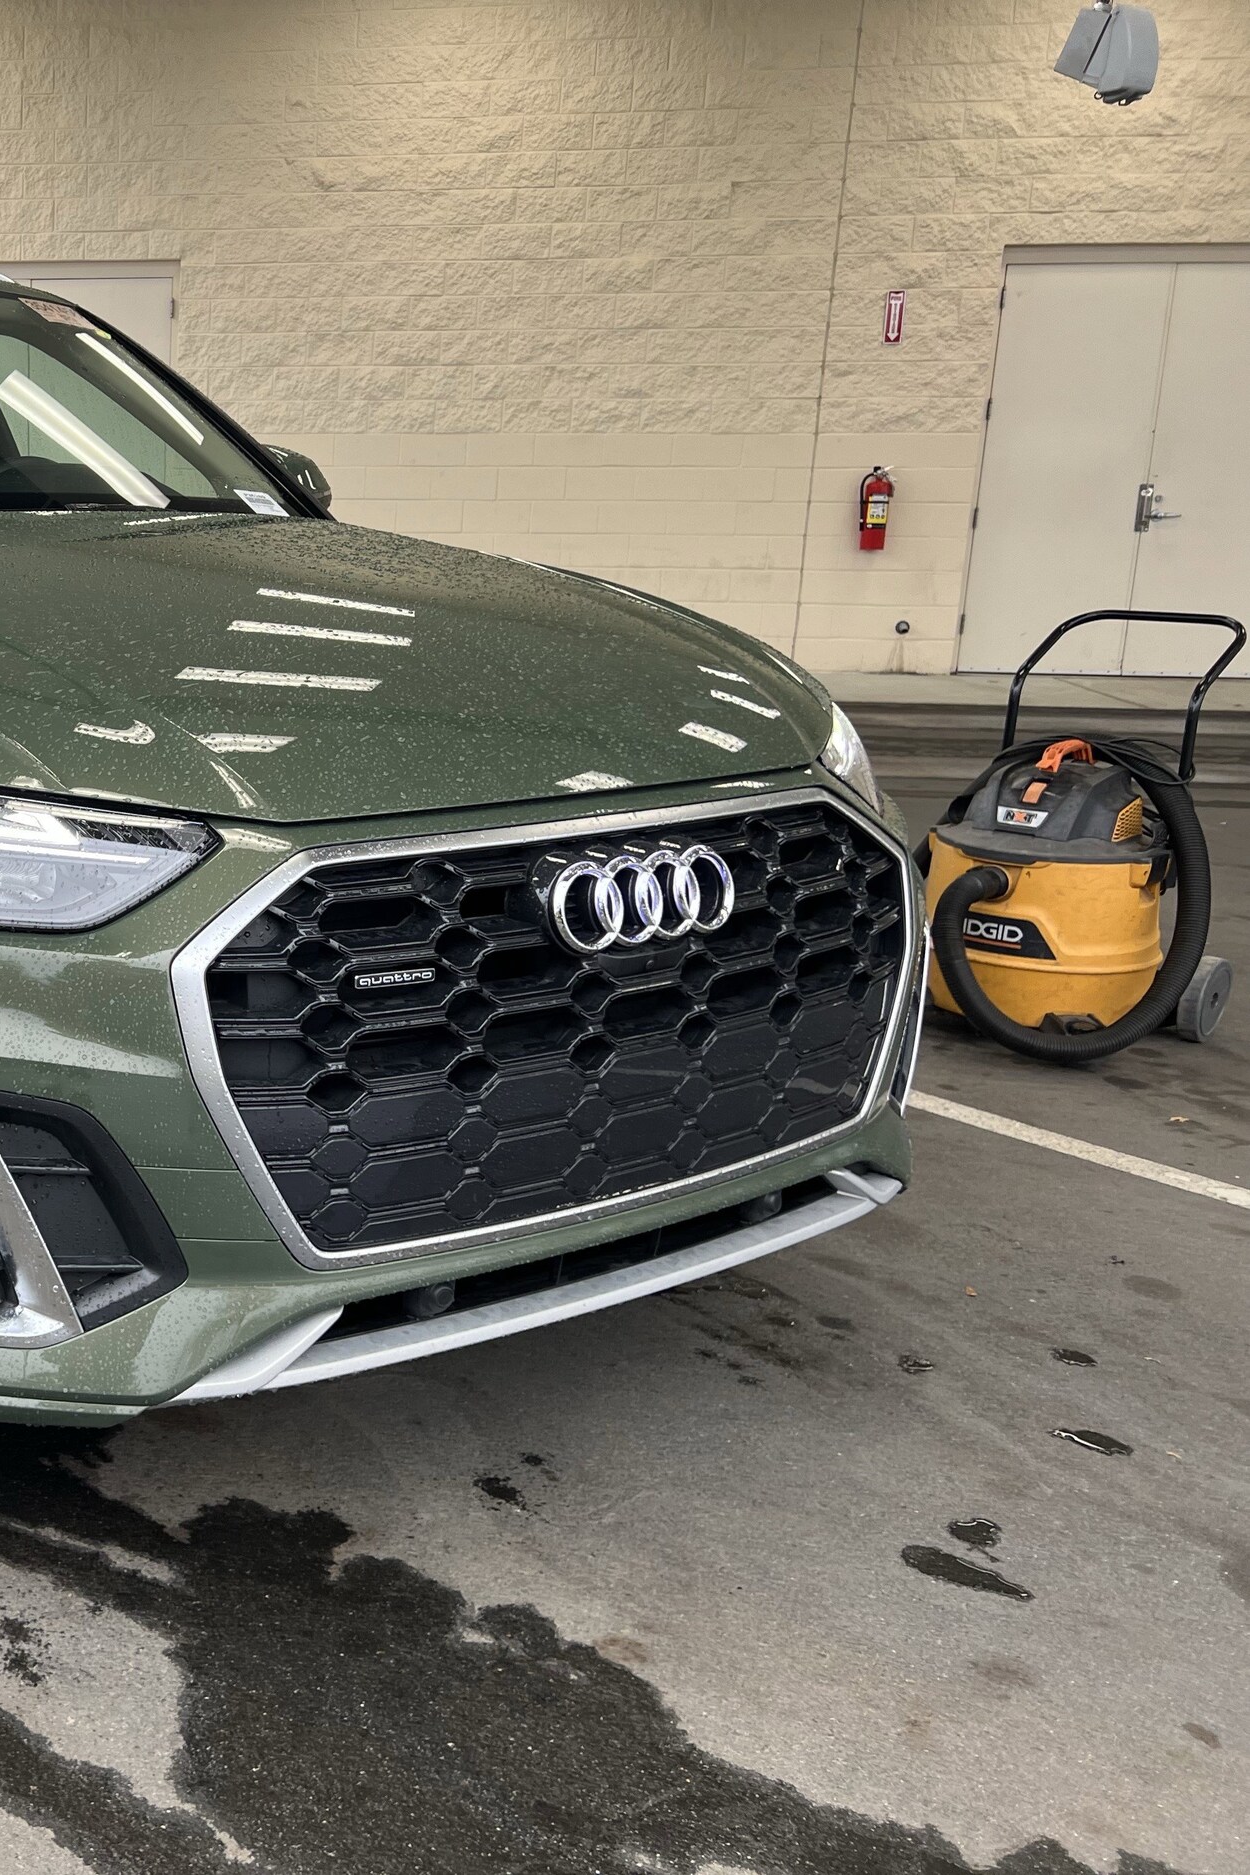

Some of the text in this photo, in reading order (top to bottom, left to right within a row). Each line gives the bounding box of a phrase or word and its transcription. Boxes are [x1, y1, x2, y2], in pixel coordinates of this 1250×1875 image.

[1003, 809, 1036, 824] NXT
[963, 918, 1024, 943] IDGID
[359, 971, 433, 987] quattro
